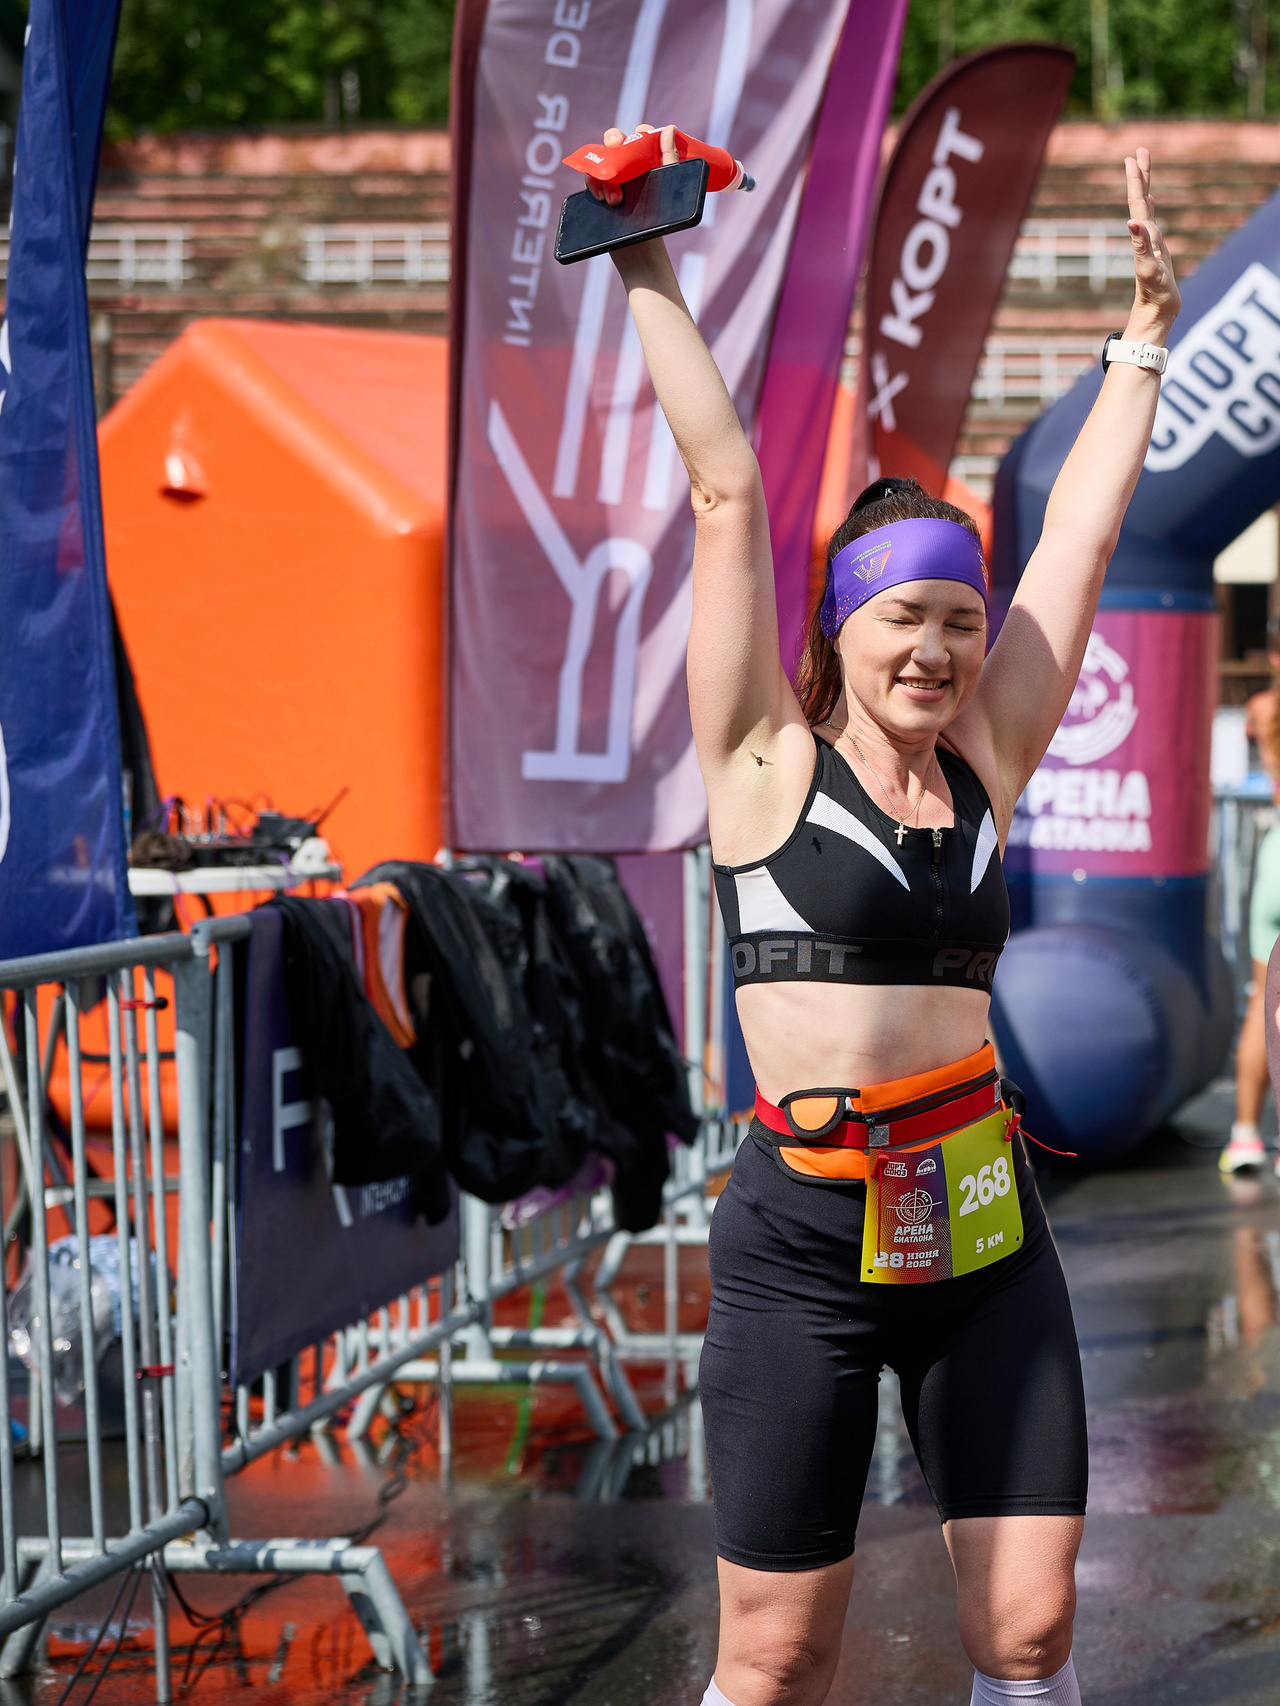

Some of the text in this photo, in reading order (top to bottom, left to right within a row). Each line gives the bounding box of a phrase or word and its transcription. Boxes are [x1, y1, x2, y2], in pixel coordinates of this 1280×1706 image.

[879, 105, 985, 349] КОРТ
[1018, 768, 1153, 819] РЕНА
[958, 1156, 1011, 1218] 268
[894, 1223, 934, 1236] АРЕНА
[976, 1238, 984, 1254] 5
[873, 1251, 905, 1268] 28
[906, 1259, 932, 1268] 2026
